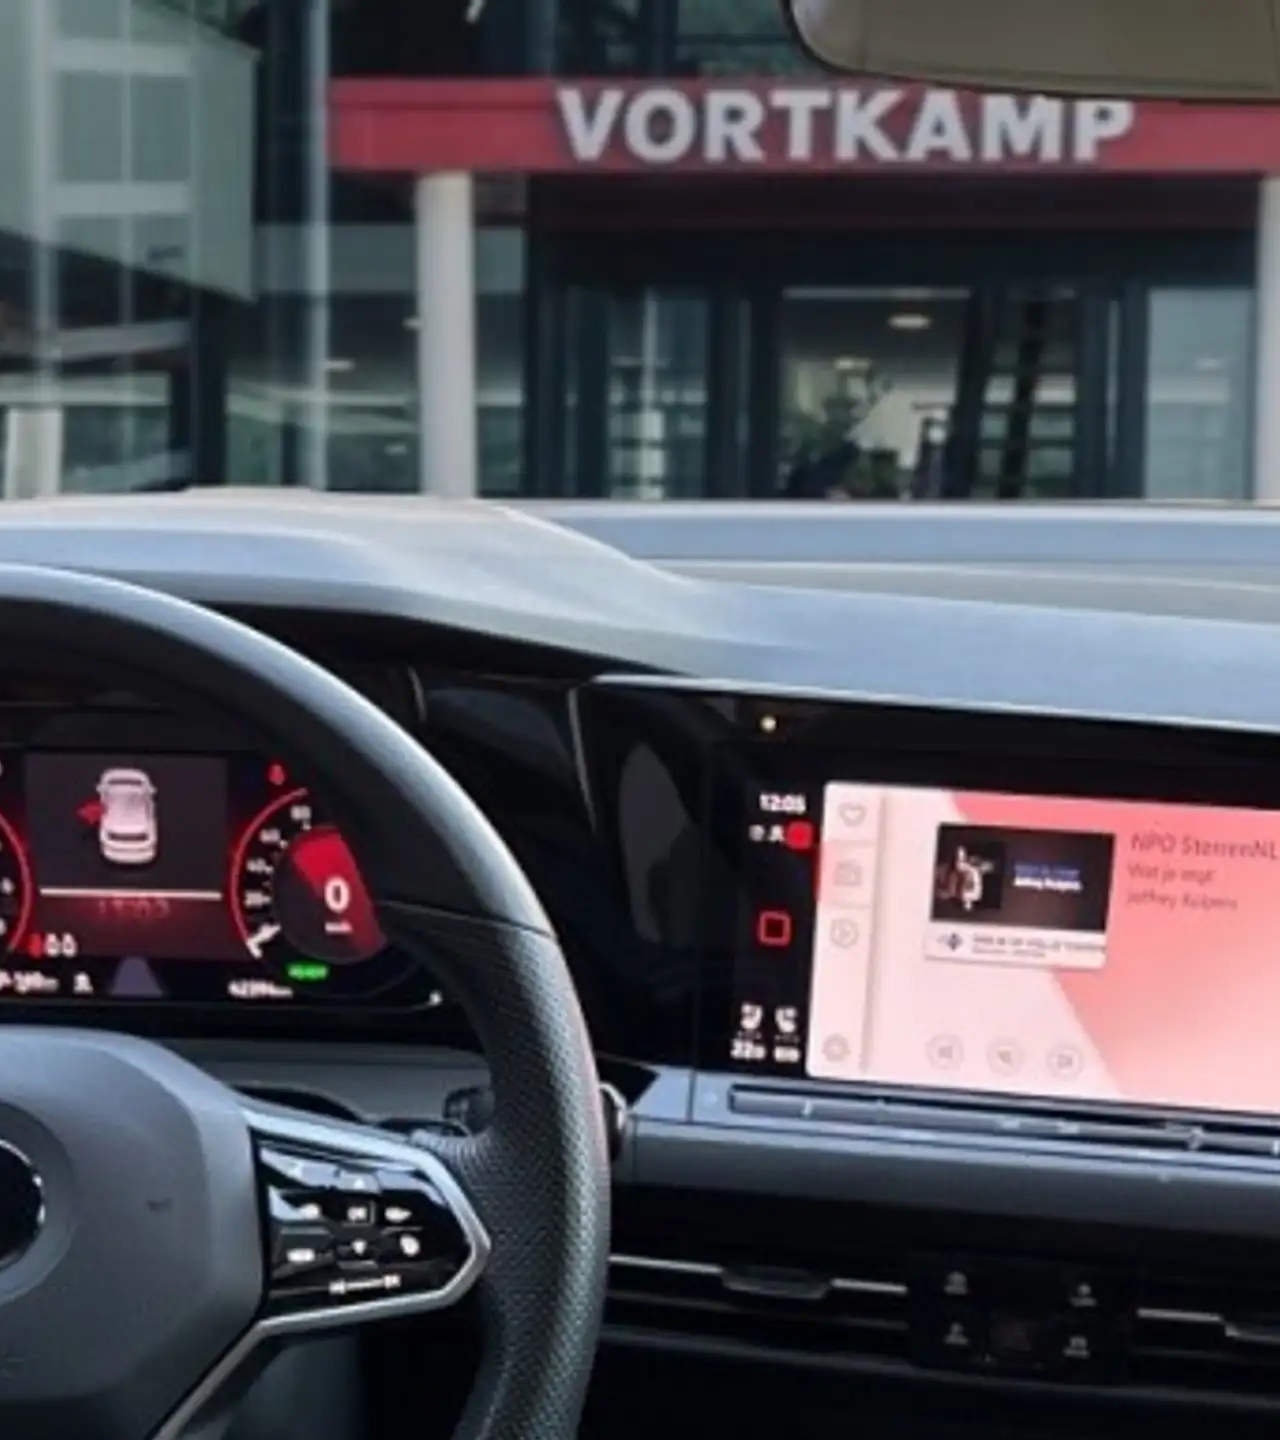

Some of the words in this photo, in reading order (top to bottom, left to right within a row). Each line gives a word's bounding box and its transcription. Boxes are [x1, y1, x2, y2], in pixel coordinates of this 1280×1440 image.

[555, 87, 1134, 163] VORTKAMP
[1130, 832, 1177, 854] NPO
[323, 876, 351, 912] 0
